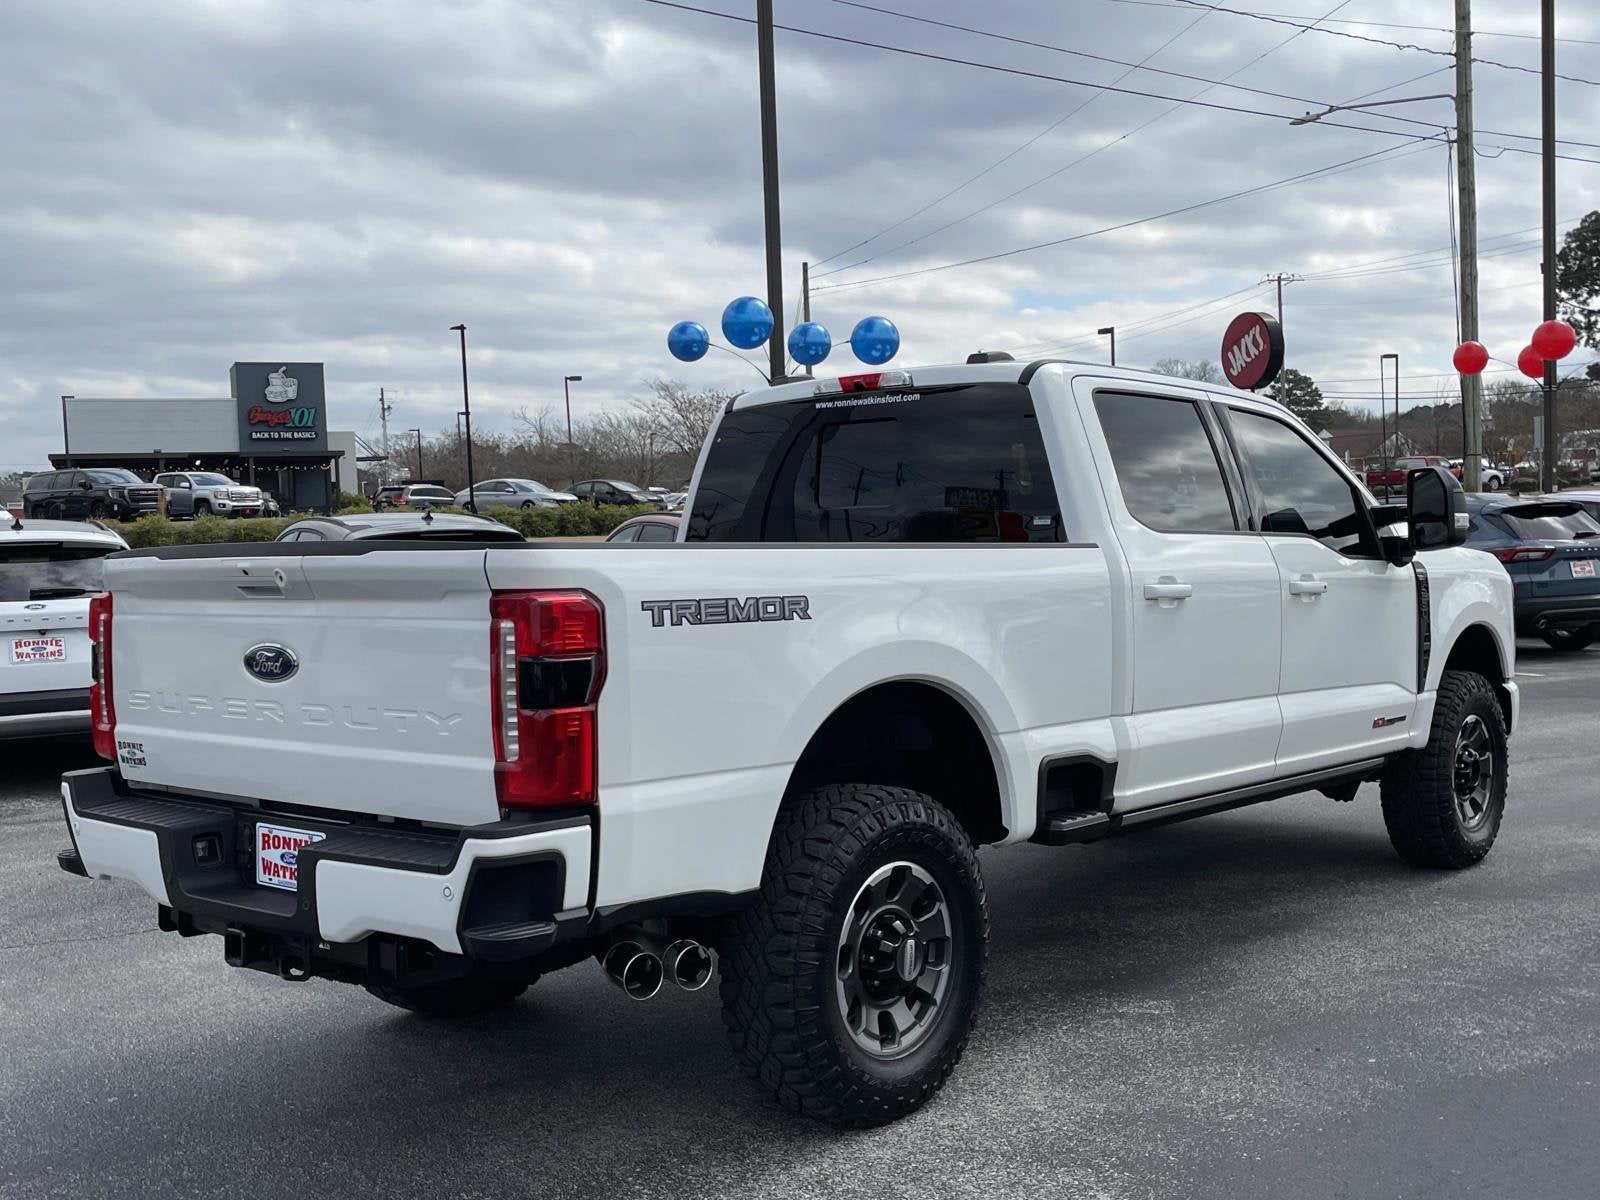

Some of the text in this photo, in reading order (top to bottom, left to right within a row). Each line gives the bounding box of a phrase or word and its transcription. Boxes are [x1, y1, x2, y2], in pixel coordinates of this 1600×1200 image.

[1227, 324, 1264, 376] JACK'S
[815, 393, 920, 409] www.ronniewatkinsford.com
[248, 404, 316, 427] Burger 101
[251, 431, 316, 439] BACK TO THE BASICS
[641, 595, 812, 627] TREMOR
[14, 639, 63, 649] RONNIE
[15, 649, 63, 659] WATKINS
[253, 650, 283, 674] Ford
[127, 690, 463, 735] SUPER DUTY
[117, 740, 144, 753] RONNIE
[120, 754, 147, 767] WATKINS
[261, 832, 312, 852] RONN
[261, 856, 297, 881] WATK
